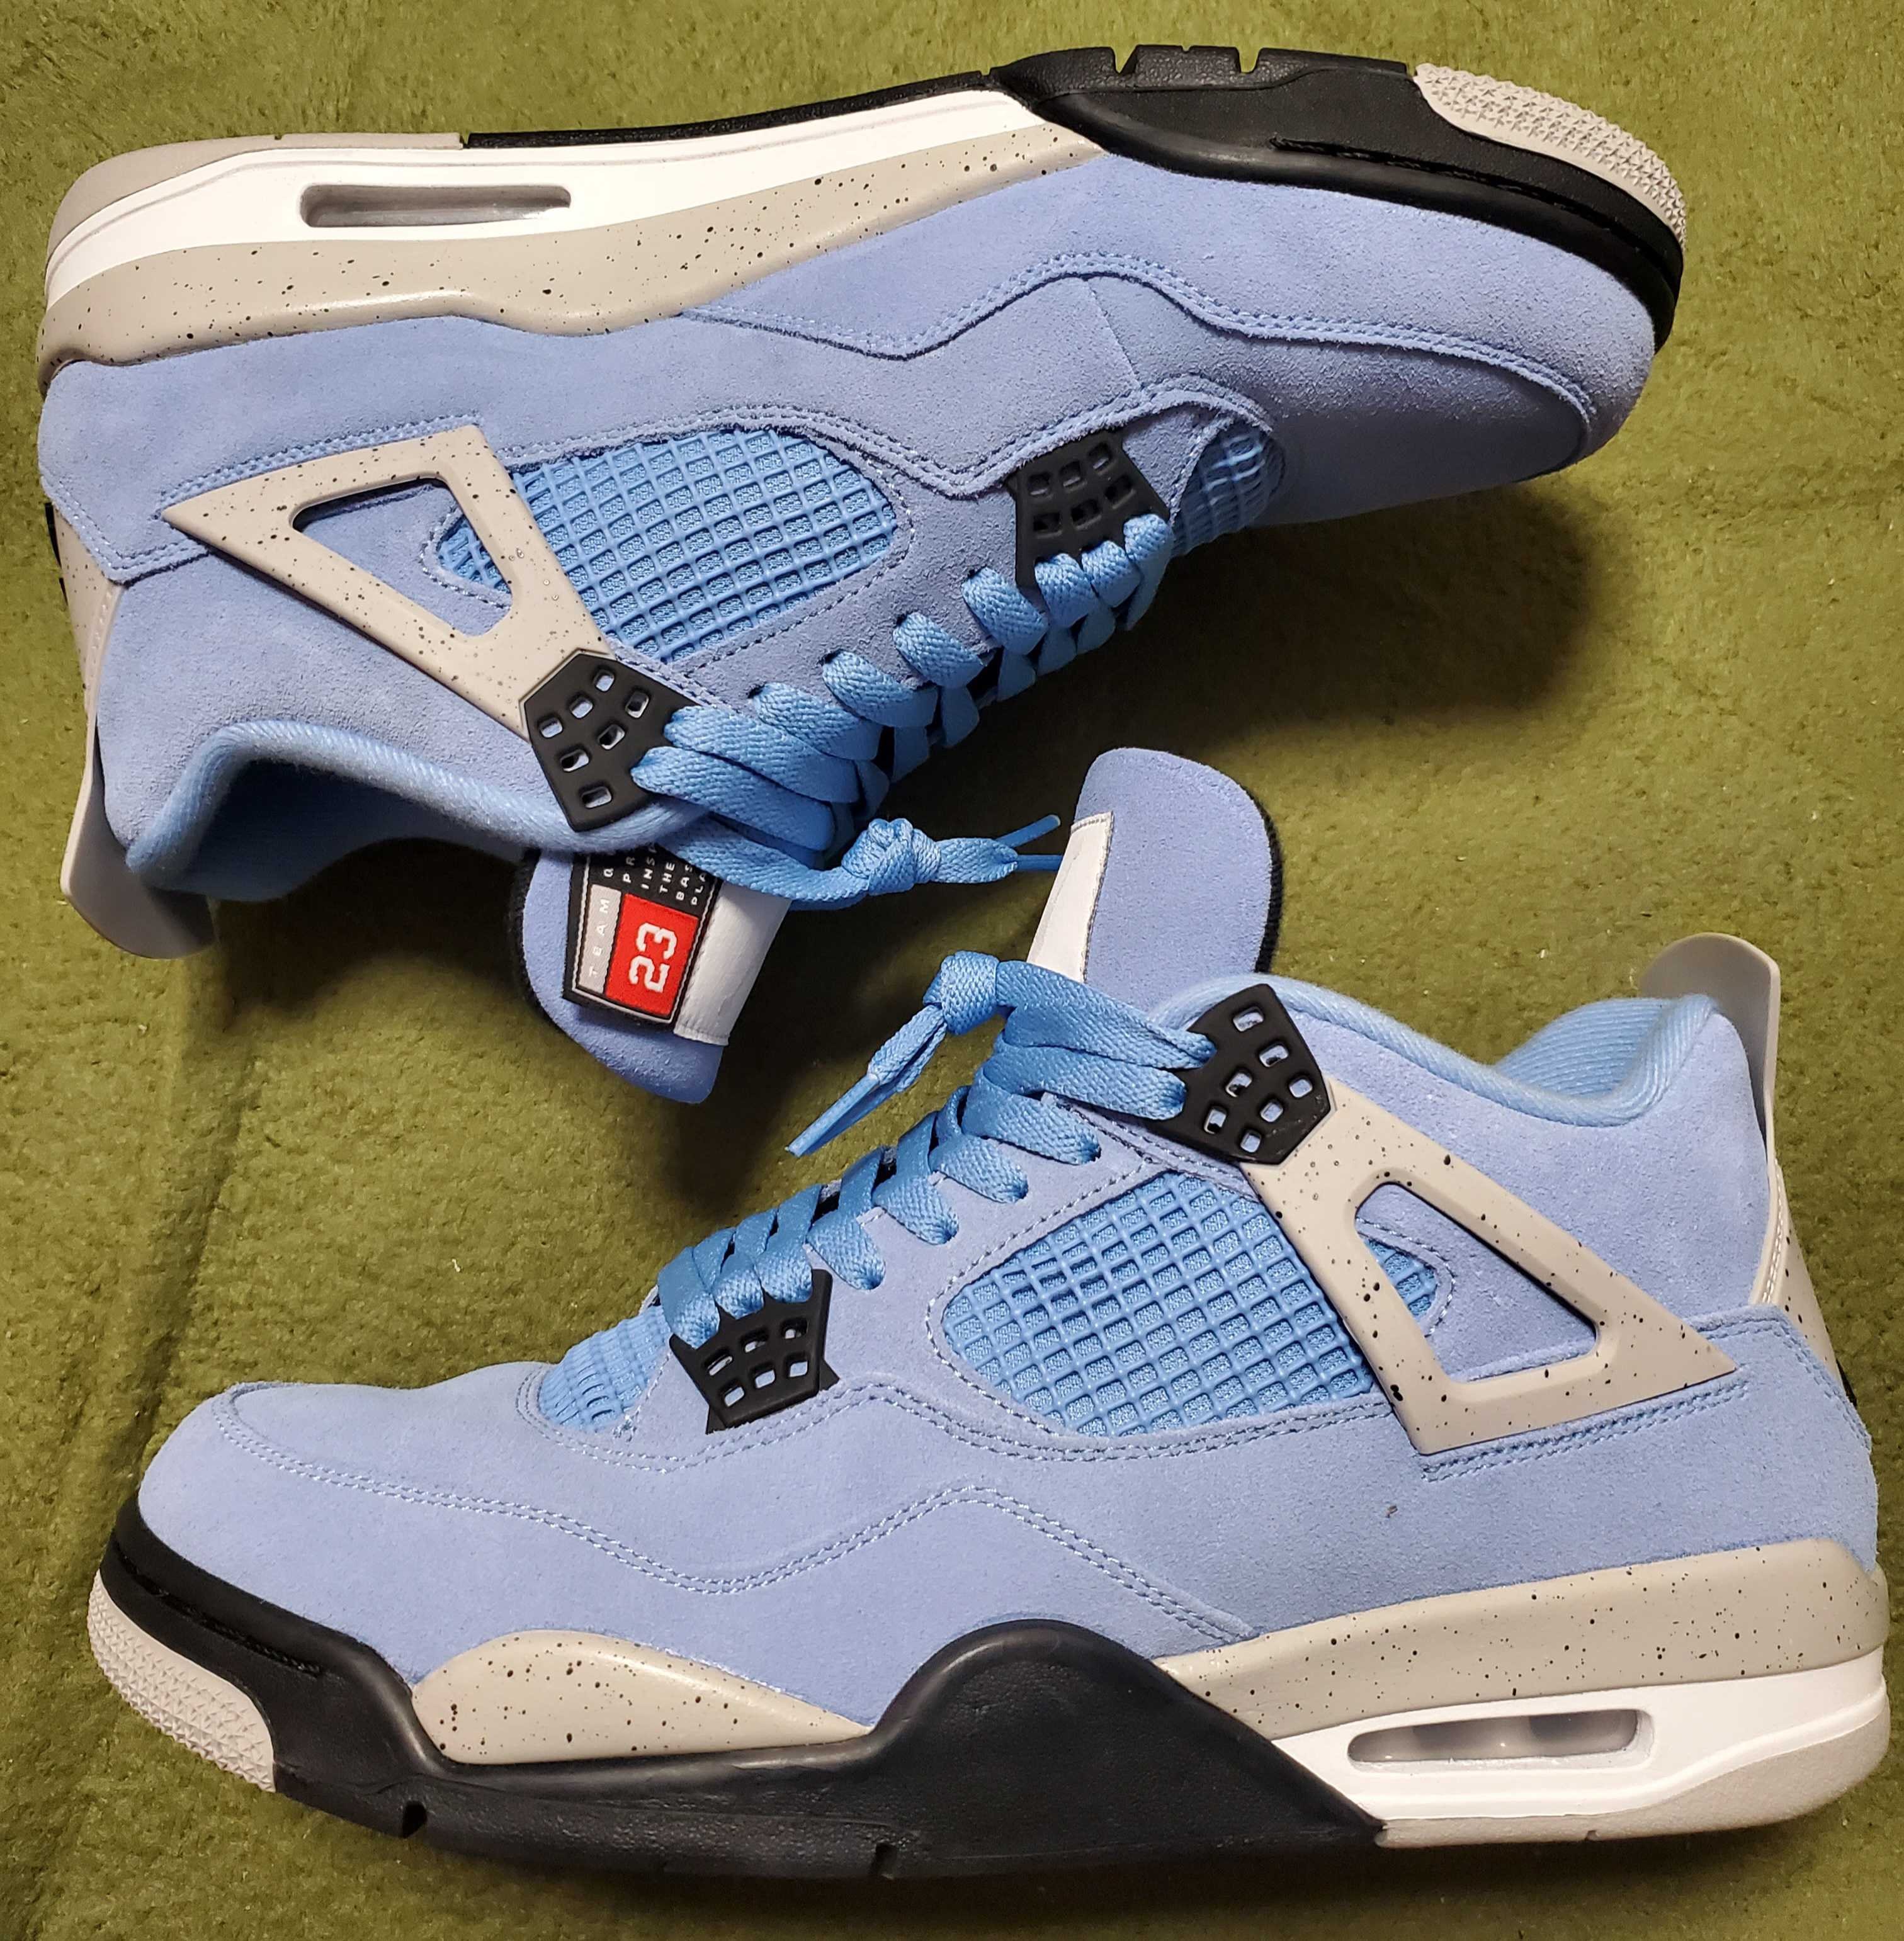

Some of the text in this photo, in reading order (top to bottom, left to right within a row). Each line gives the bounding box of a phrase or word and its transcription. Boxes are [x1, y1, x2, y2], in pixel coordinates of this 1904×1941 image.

[660, 862, 675, 893] THE
[589, 898, 610, 978] TEAM
[630, 922, 677, 993] 23
